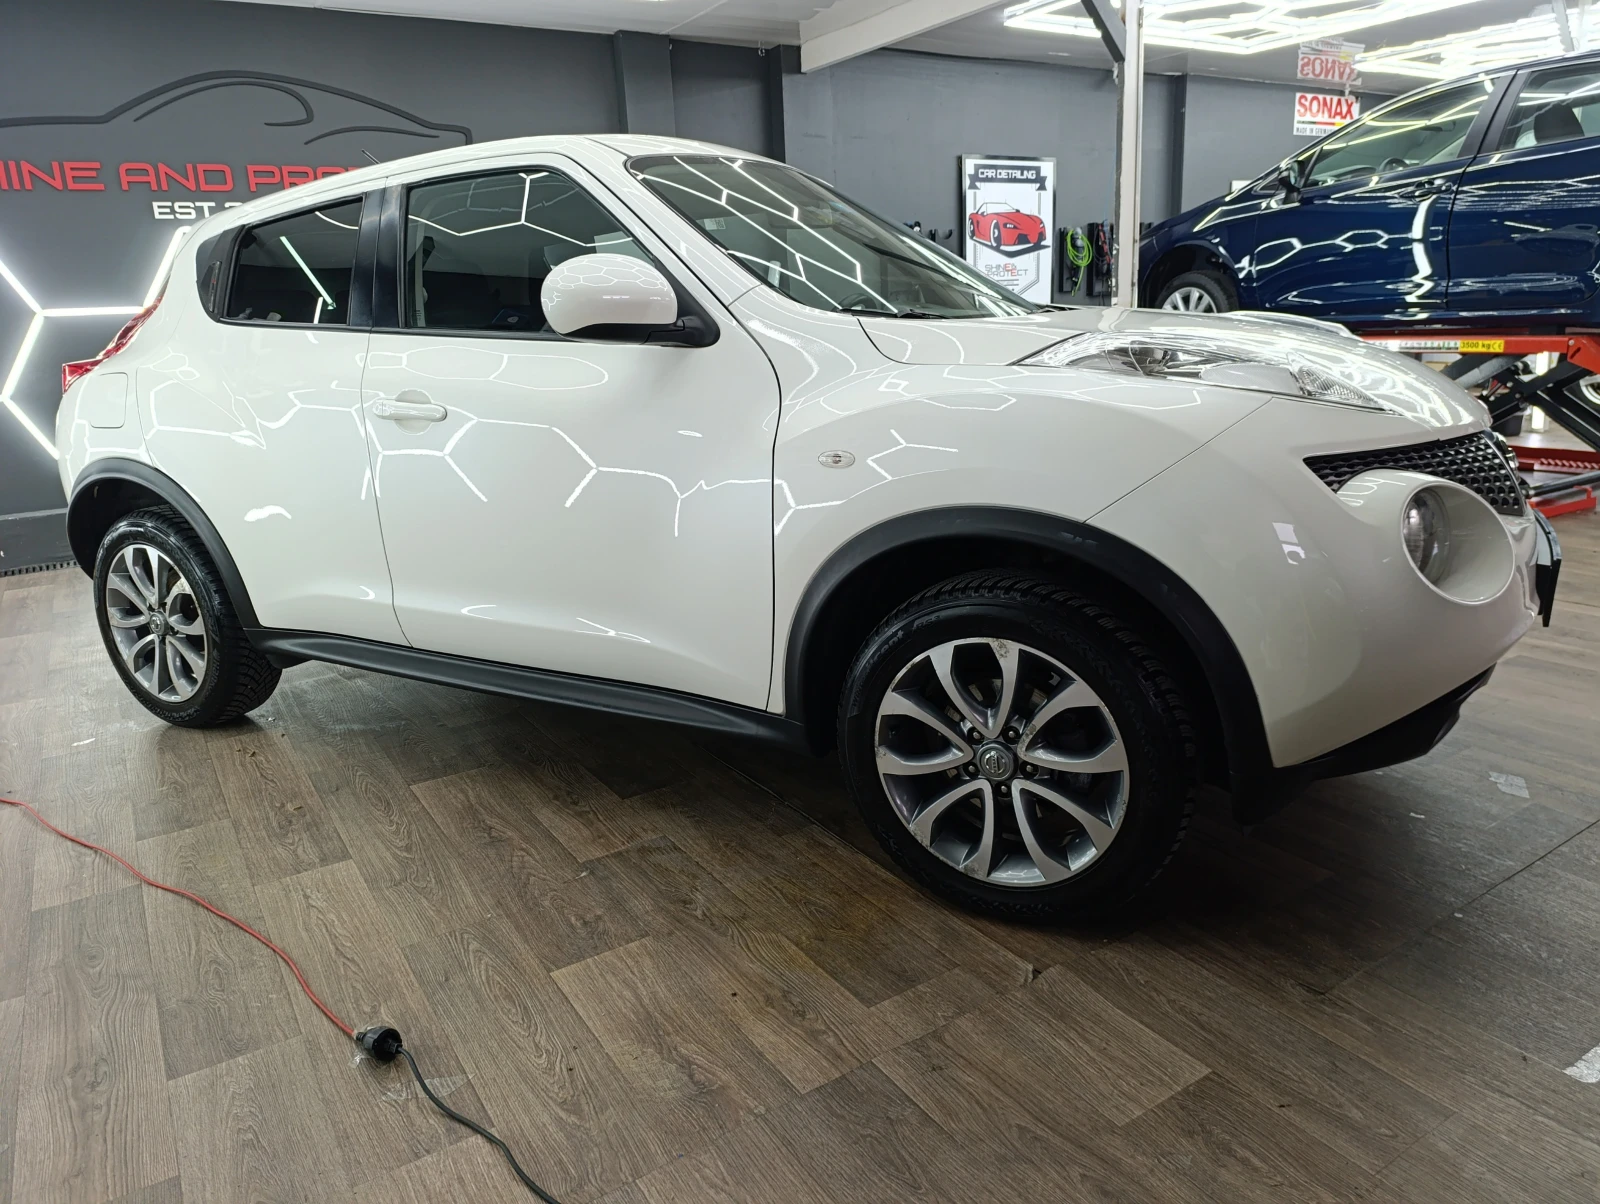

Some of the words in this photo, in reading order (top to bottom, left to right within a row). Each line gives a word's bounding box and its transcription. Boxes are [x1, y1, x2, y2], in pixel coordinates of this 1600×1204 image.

[1297, 94, 1354, 120] SONAX
[118, 163, 234, 192] AND
[246, 165, 361, 192] PR
[979, 169, 996, 178] CAR
[152, 201, 216, 219] EST
[987, 268, 1028, 278] PROTECT
[1460, 341, 1480, 349] 3500
[1482, 341, 1491, 350] kg
